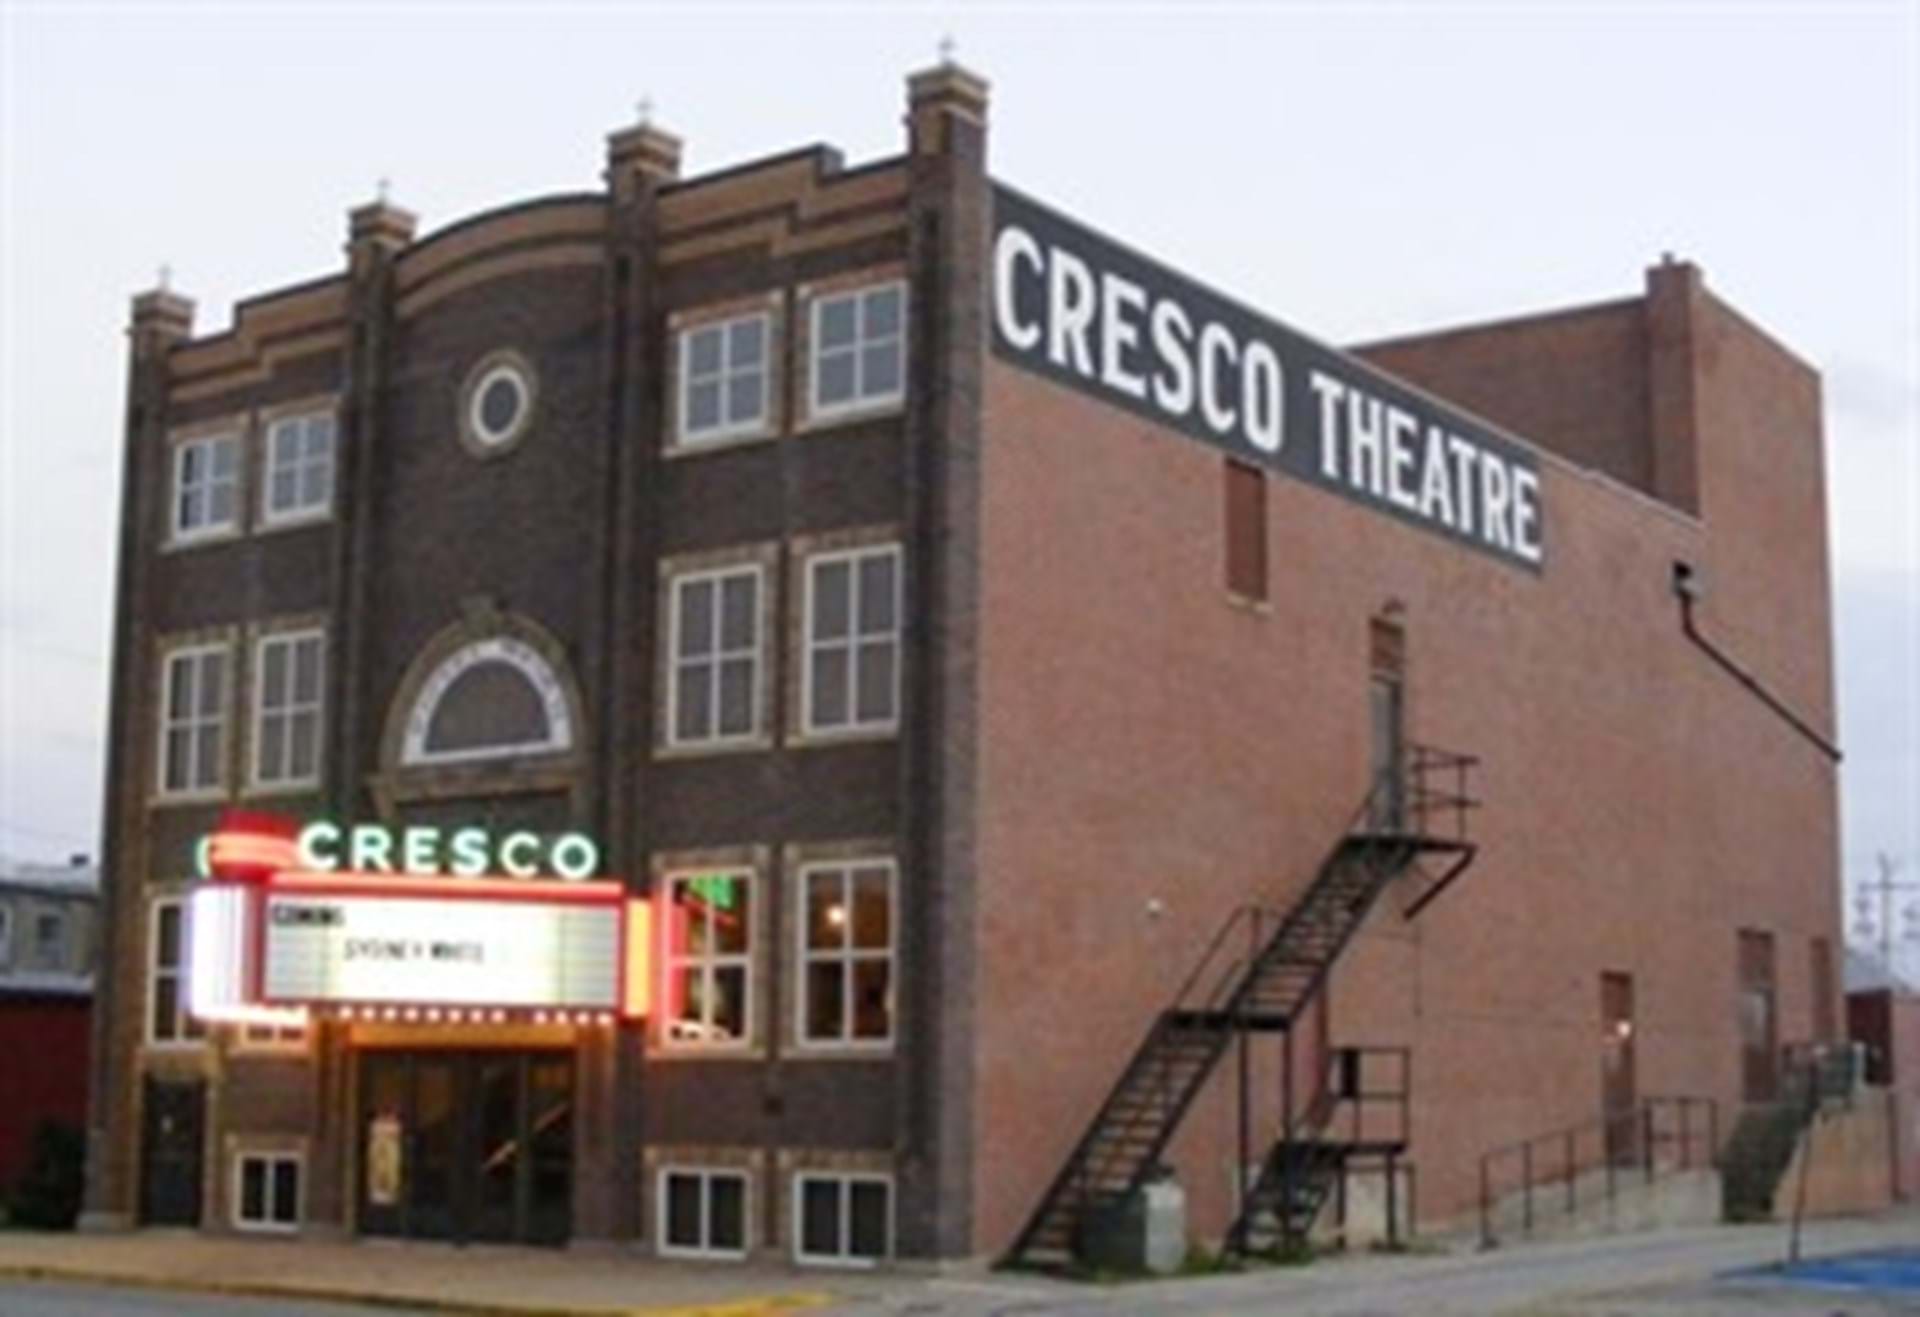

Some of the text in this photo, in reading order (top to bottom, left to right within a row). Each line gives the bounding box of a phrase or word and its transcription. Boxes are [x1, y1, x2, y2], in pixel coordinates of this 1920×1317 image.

[993, 226, 1542, 564] CRESCO THEATRE
[298, 822, 598, 880] CRESCO
